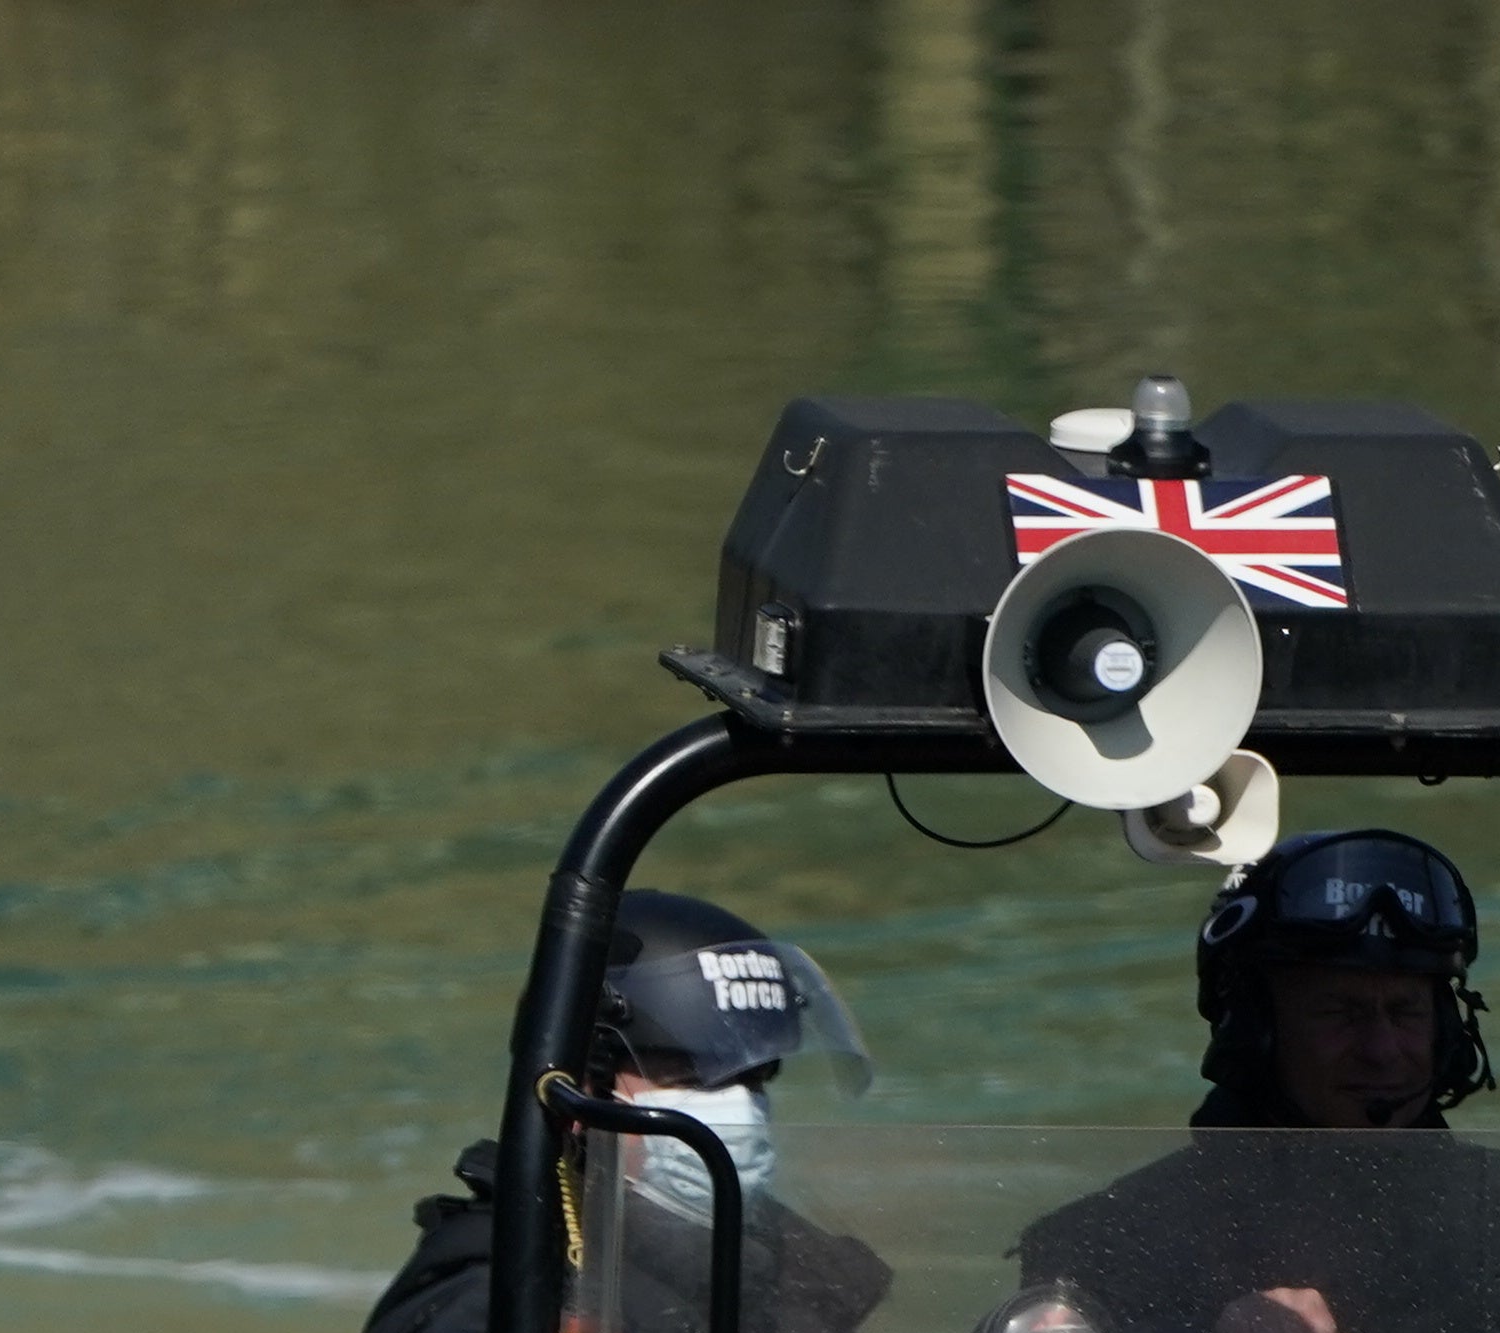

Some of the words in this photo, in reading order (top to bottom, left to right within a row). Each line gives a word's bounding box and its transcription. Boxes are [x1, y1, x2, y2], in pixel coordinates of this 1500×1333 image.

[1325, 879, 1424, 916] Boer
[697, 949, 784, 981] Border
[713, 979, 786, 1011] Force
